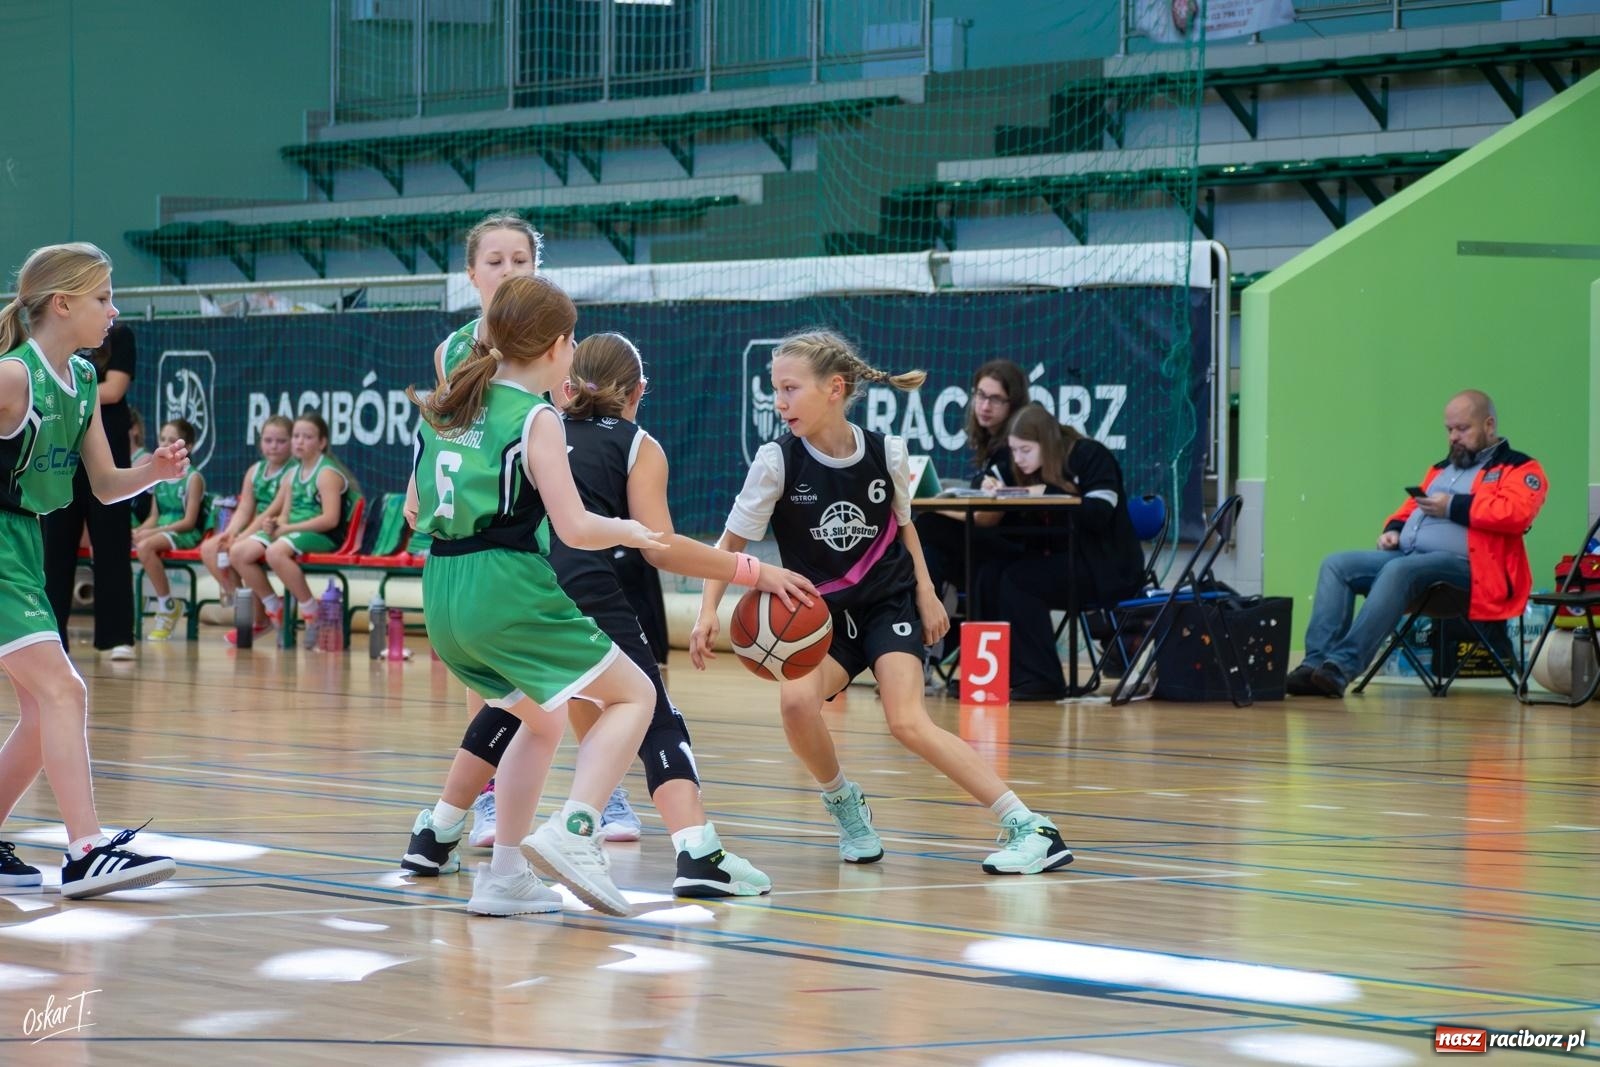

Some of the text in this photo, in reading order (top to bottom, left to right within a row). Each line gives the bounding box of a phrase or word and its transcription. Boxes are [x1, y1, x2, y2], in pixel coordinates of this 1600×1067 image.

[866, 362, 1127, 450] RACÓRZ
[435, 426, 484, 449] IBÓRZ
[434, 450, 463, 520] 6
[790, 493, 818, 502] USTROŃ
[867, 478, 887, 504] 6
[967, 630, 1002, 686] 5
